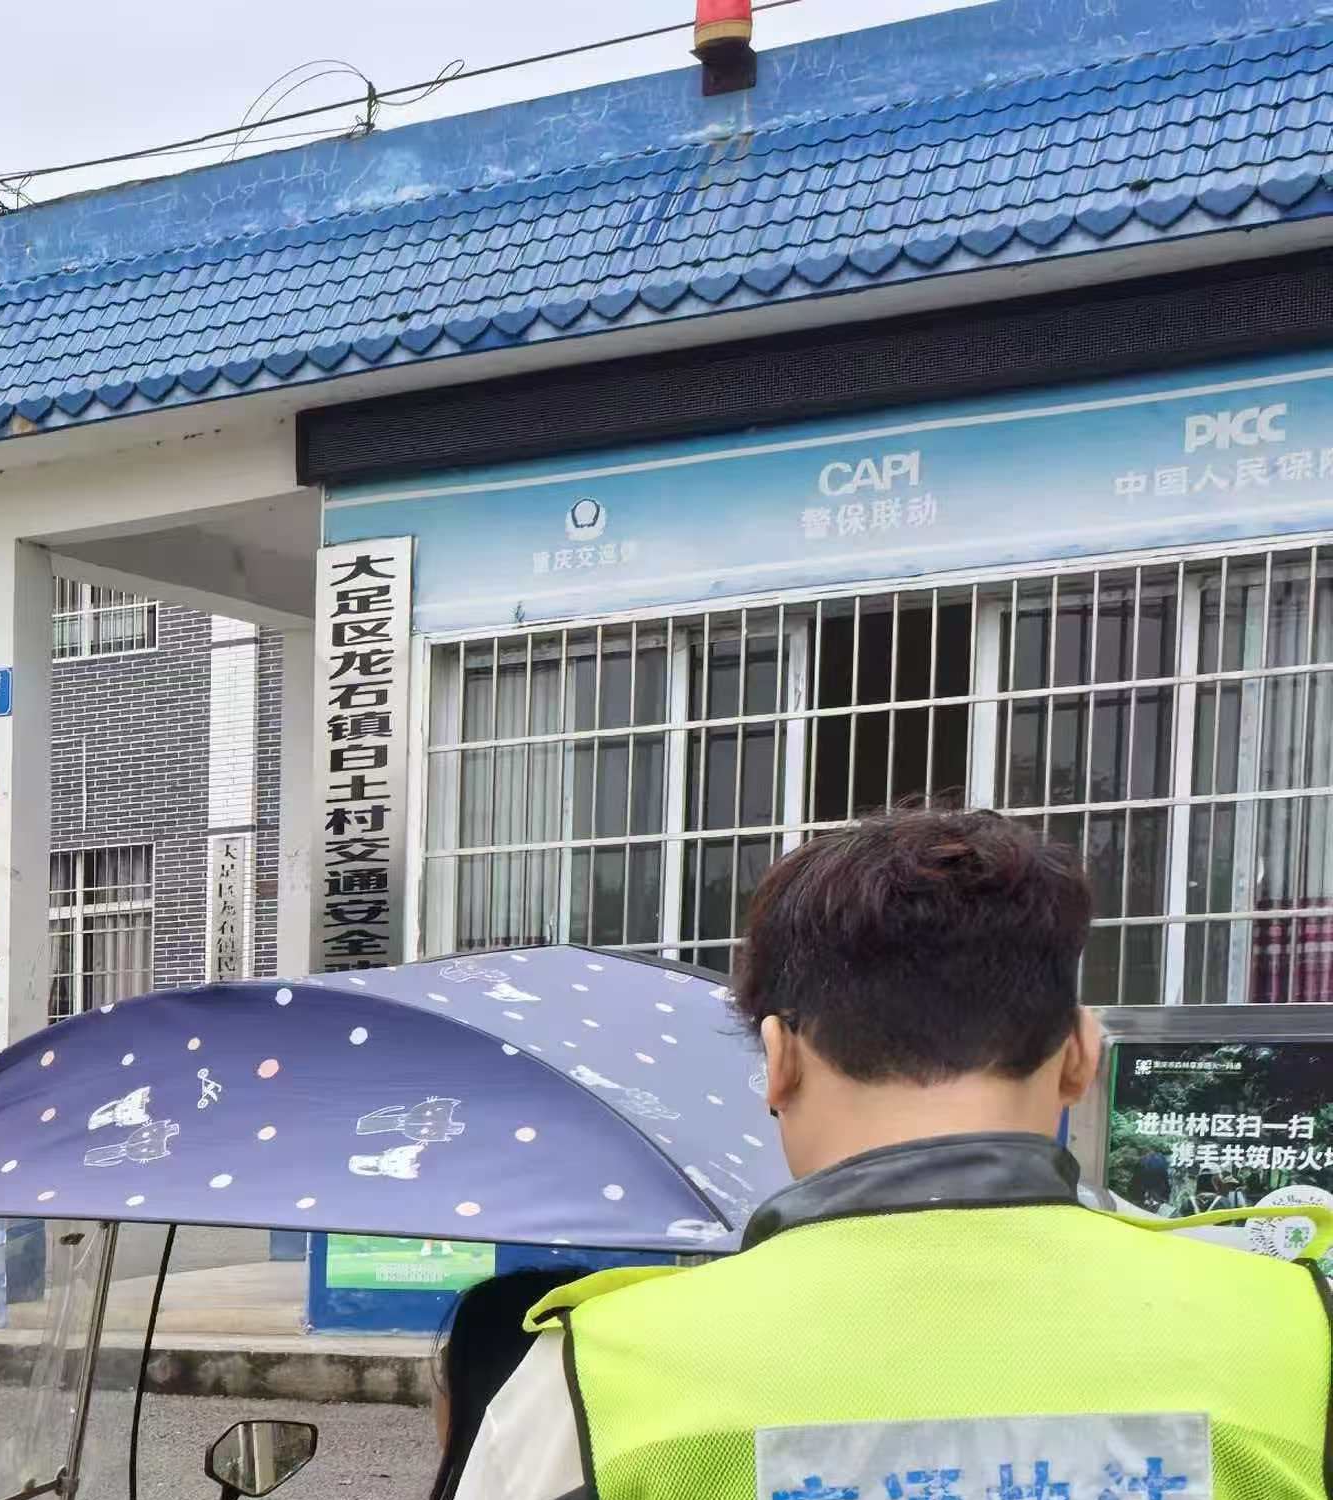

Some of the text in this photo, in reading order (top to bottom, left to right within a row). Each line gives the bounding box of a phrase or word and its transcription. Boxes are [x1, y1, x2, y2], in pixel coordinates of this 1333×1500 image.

[1183, 402, 1289, 454] PICC
[818, 450, 922, 497] CAPI
[800, 492, 938, 541] 警保联动
[1134, 1112, 1315, 1140] 进出林区扫一扫
